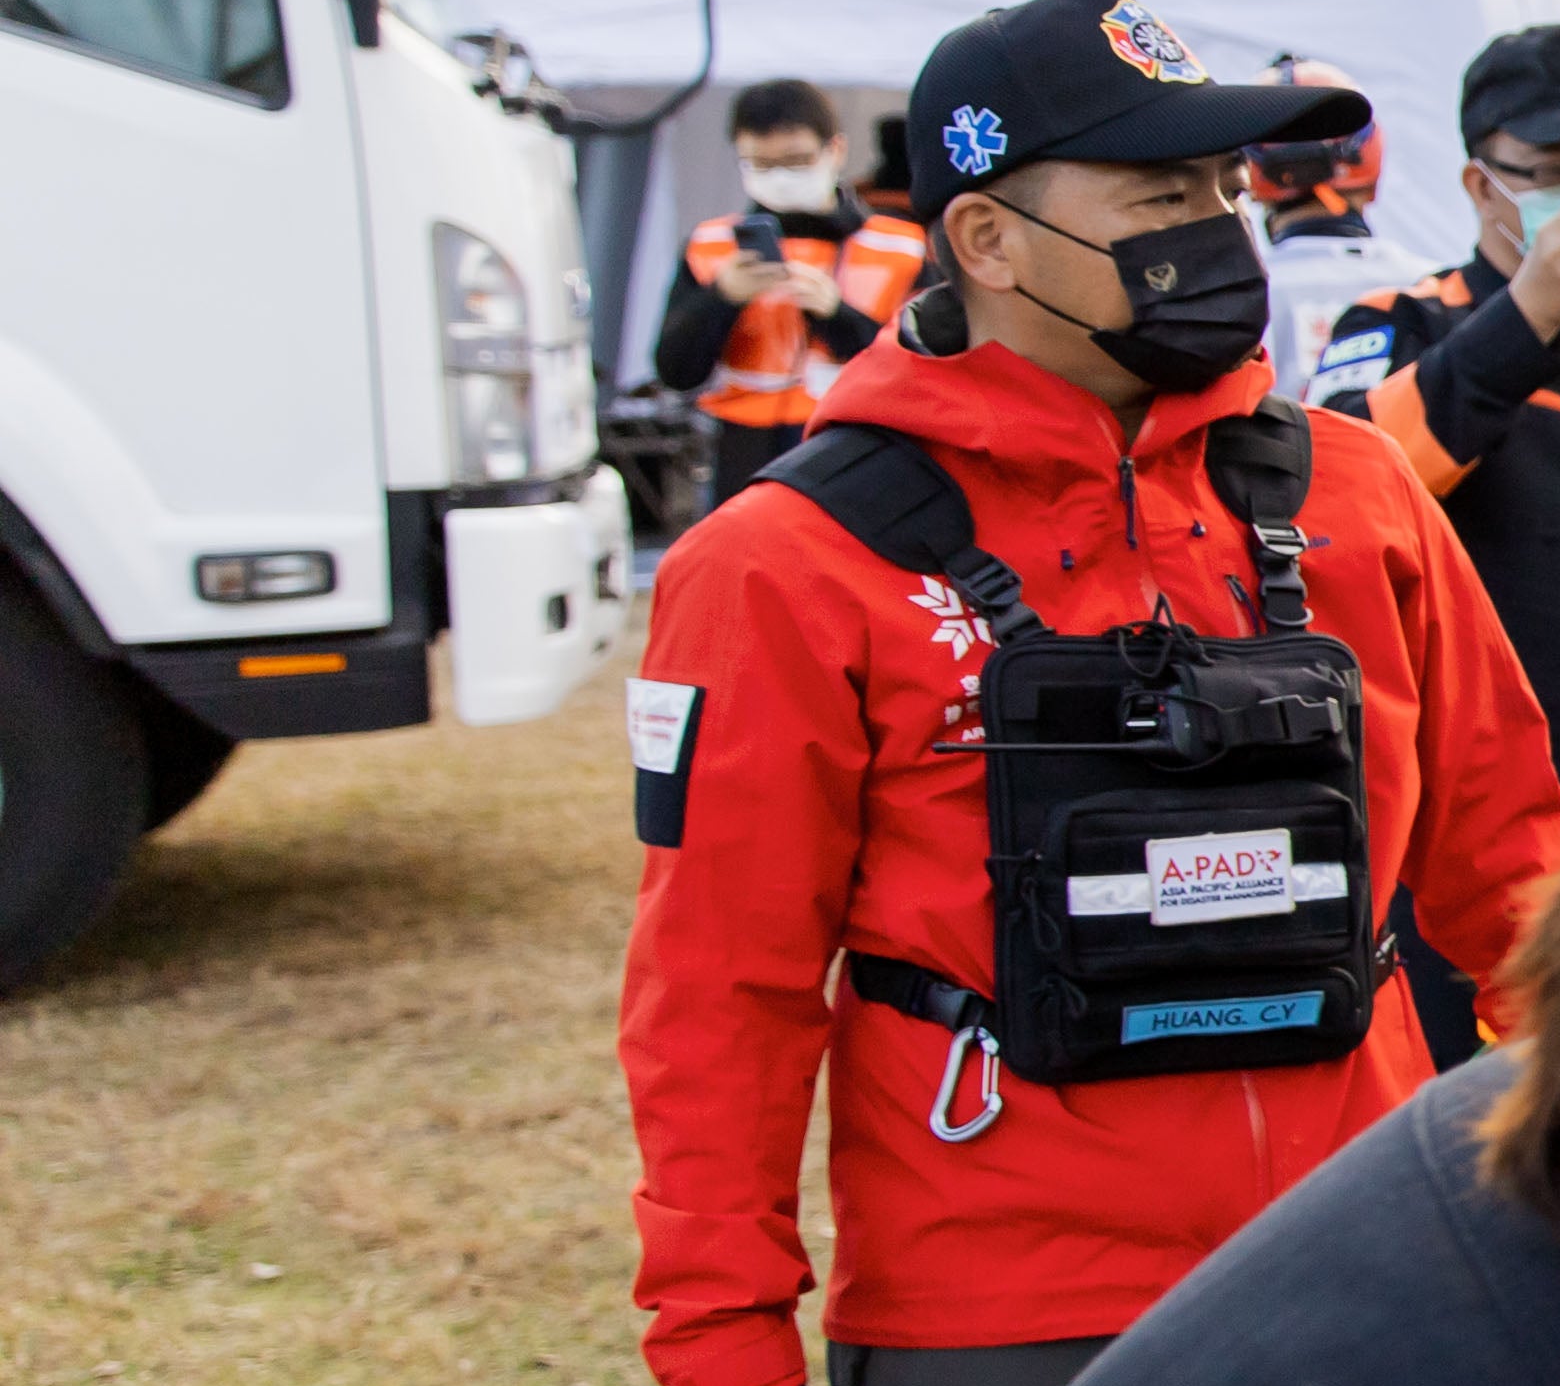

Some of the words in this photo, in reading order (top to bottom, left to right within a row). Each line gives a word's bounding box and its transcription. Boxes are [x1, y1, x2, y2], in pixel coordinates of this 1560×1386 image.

[1161, 851, 1256, 884] A-PAD
[1160, 887, 1187, 897] ASIA
[1190, 881, 1232, 894] PACIFIC
[1235, 877, 1284, 890] ALLIANCE
[1160, 899, 1178, 907] FOR
[1180, 895, 1221, 905] DISASTER
[1224, 888, 1285, 901] MANAGEMENT
